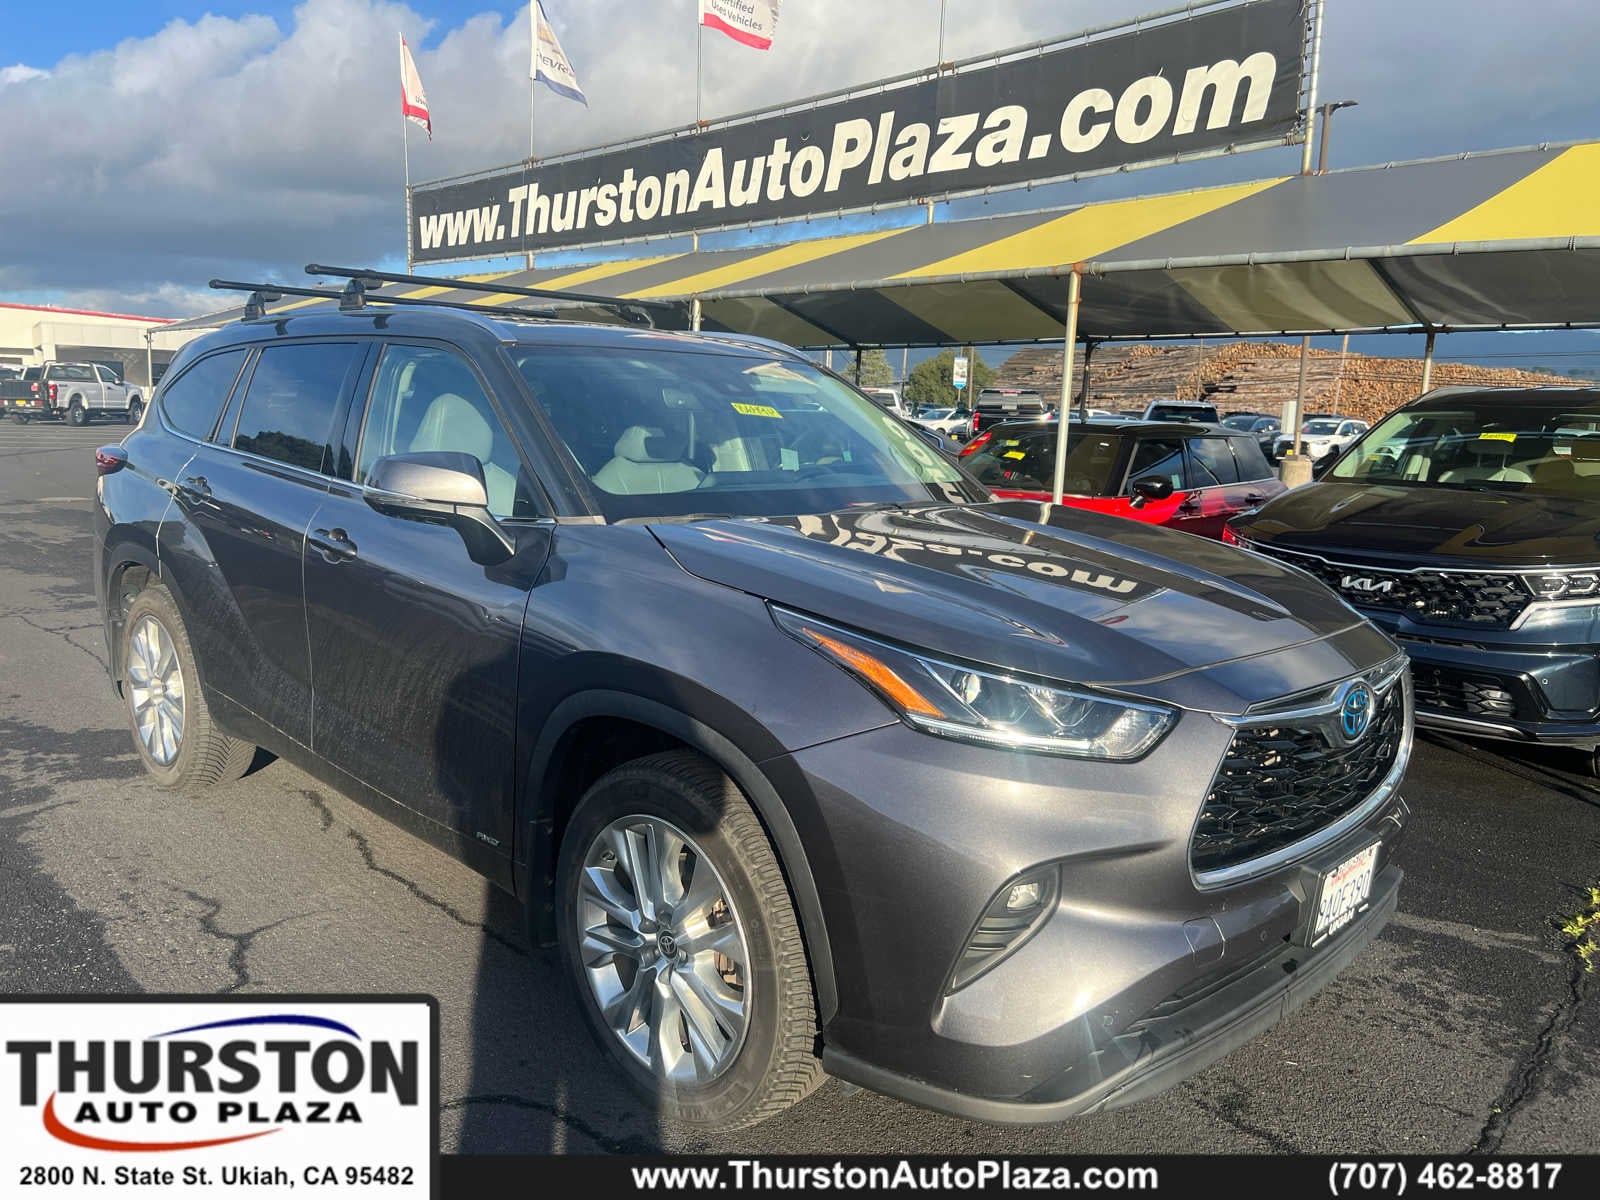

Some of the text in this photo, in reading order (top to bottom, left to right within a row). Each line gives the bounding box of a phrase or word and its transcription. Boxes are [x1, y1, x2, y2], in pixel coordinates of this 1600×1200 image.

[727, 10, 763, 31] Vehicles
[419, 51, 1277, 250] www.ThurstonAutoPlaza.com
[1341, 575, 1393, 593] KIA
